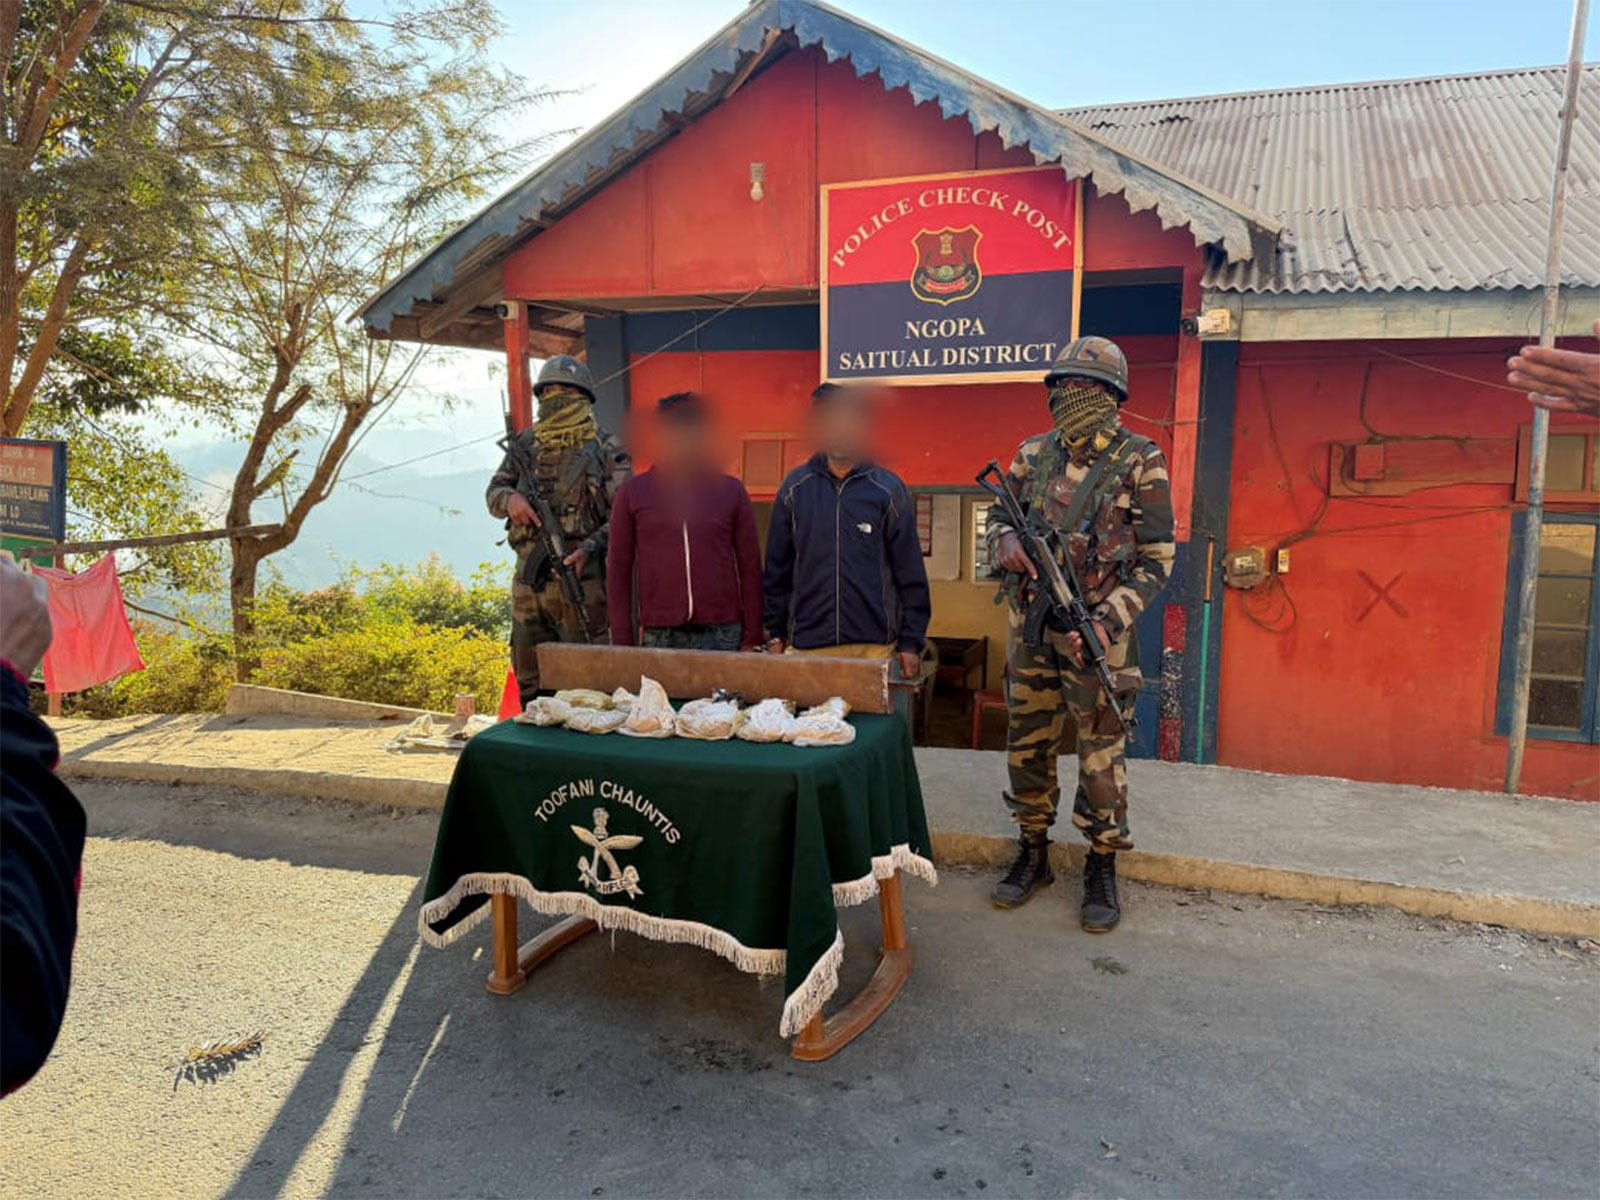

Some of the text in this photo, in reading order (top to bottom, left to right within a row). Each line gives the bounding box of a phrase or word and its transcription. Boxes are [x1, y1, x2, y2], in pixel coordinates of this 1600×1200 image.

[832, 187, 1072, 268] POLICE CHECK POST
[905, 317, 985, 339] NGOPA
[839, 343, 1056, 370] SAITUAL DISTRICT
[534, 779, 681, 844] TOOFANI CHAUNTIS
